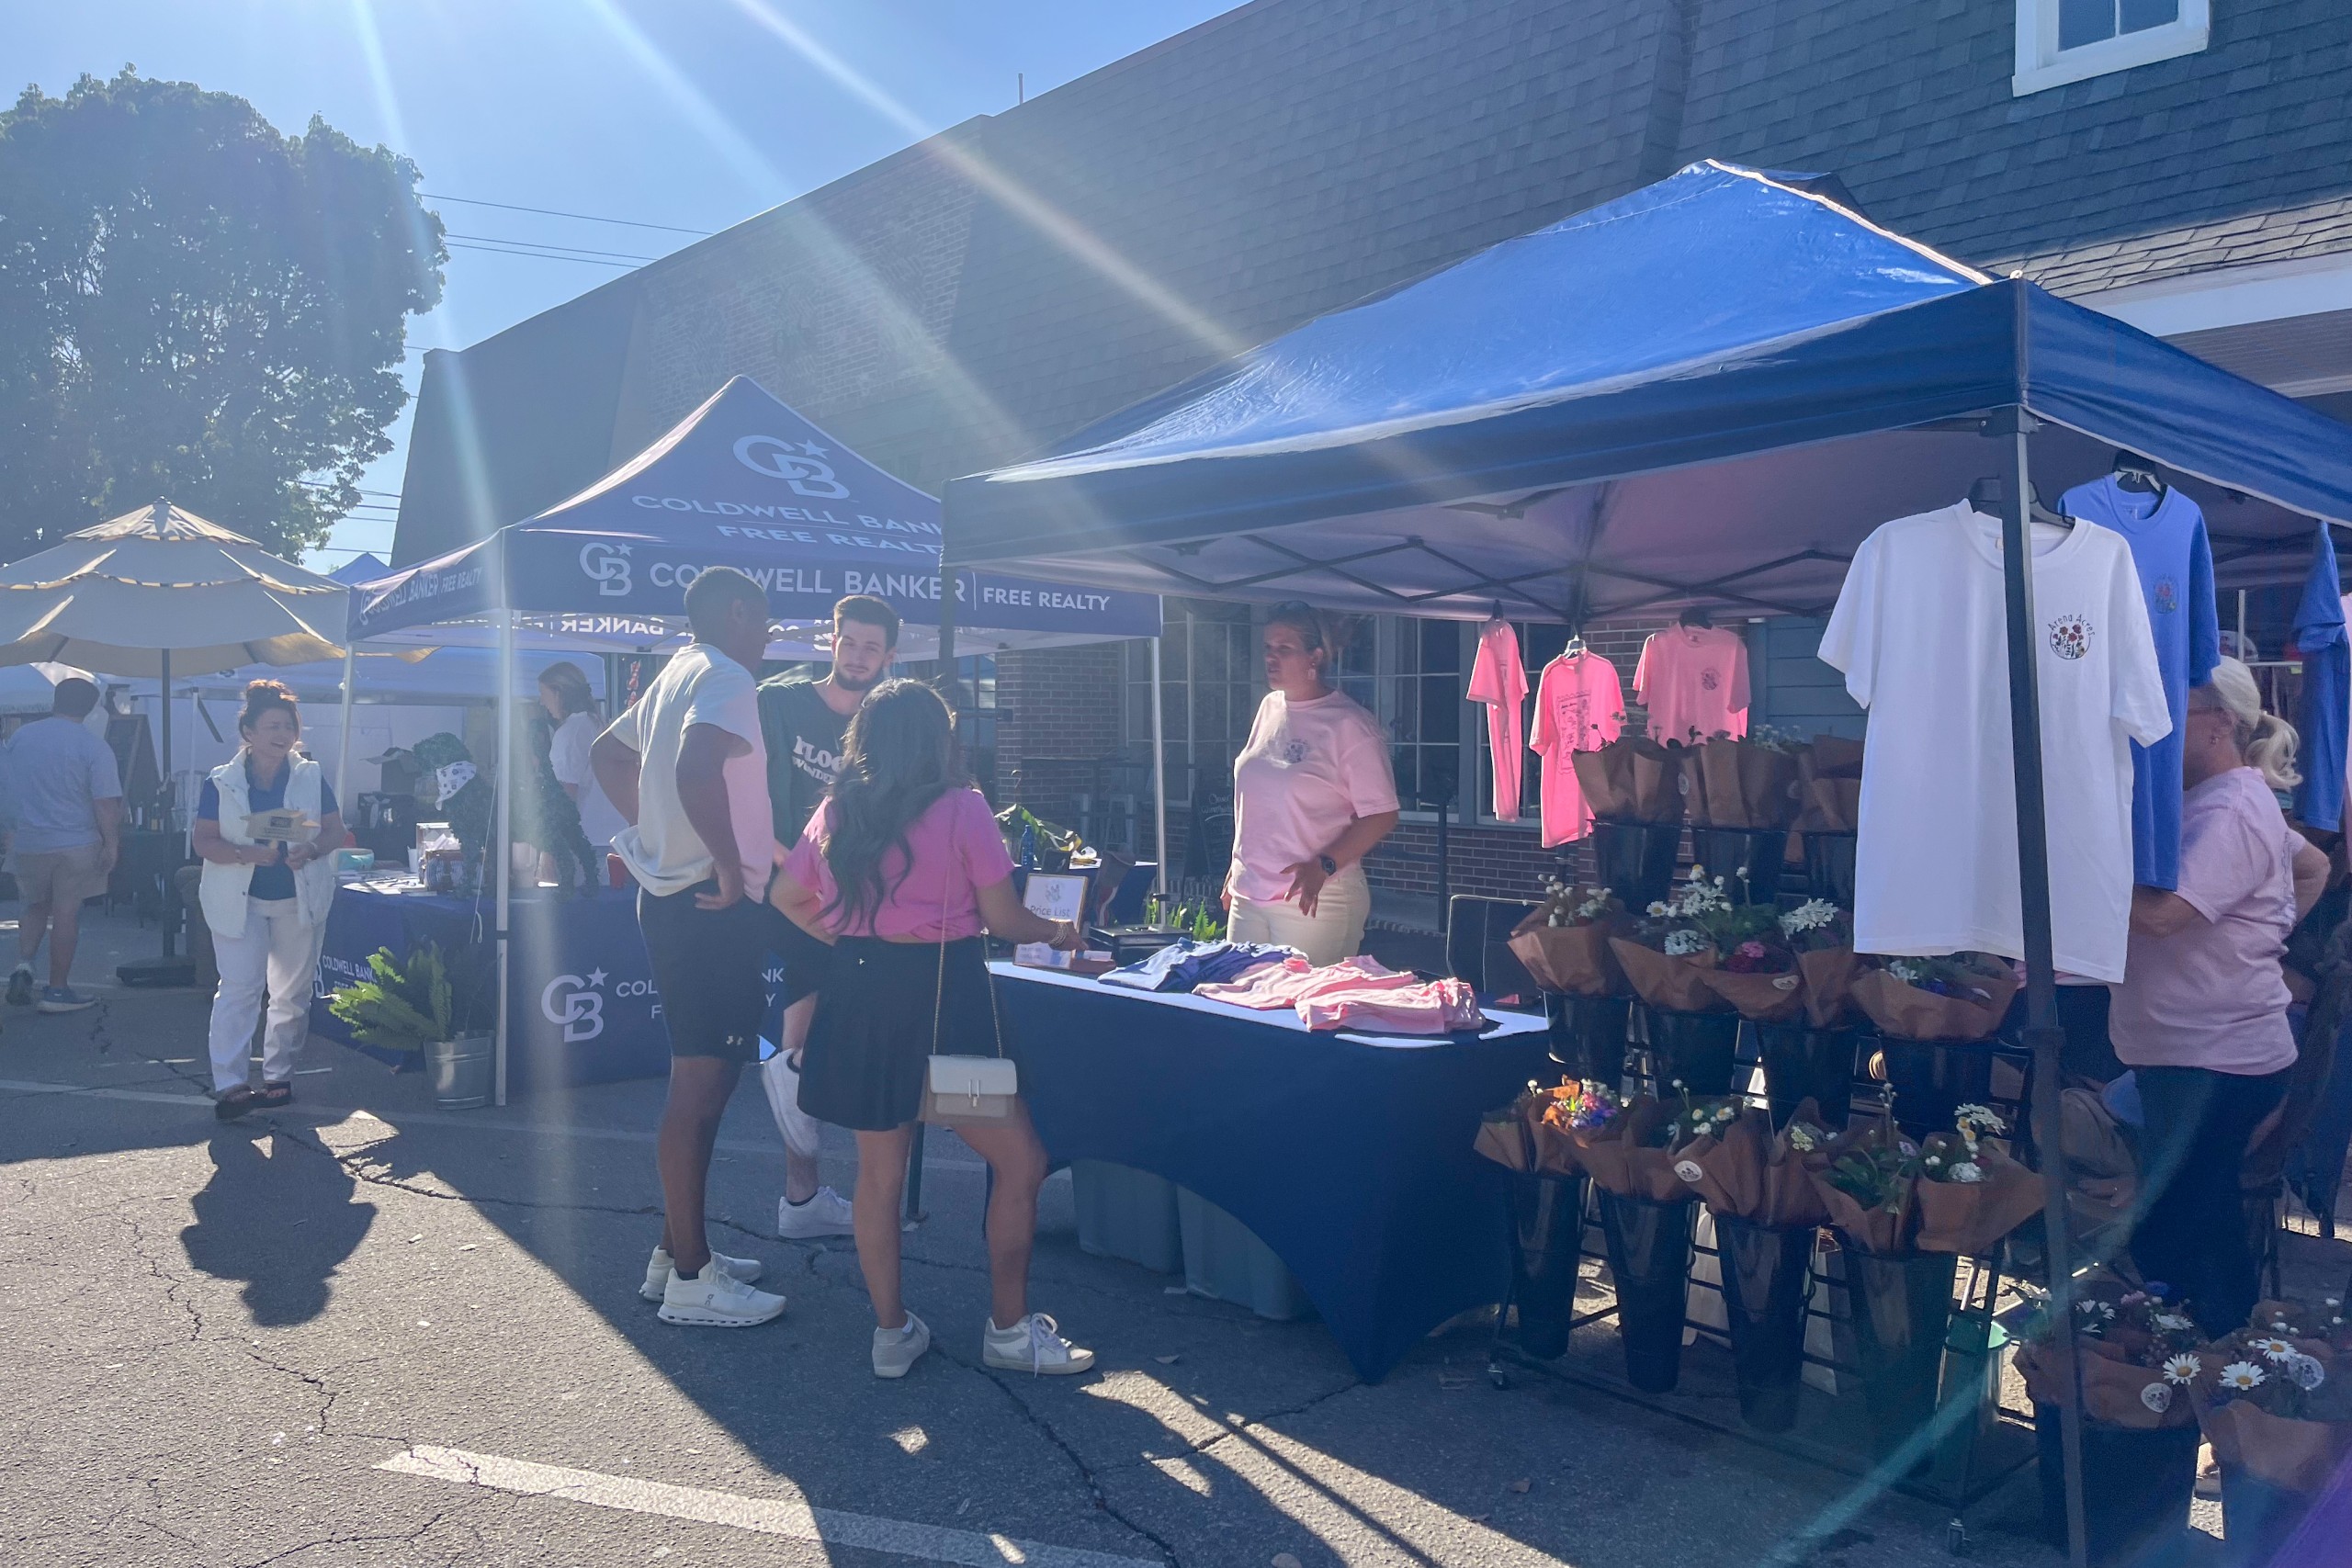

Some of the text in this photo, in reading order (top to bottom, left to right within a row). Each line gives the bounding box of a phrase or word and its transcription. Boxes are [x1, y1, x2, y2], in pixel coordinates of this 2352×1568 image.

[631, 495, 942, 536] COLDWELL BAN
[716, 525, 944, 556] FREE REALT
[441, 573, 458, 594] FREE
[458, 567, 484, 591] REALTY
[650, 561, 1110, 611] COWELL BANKER FREE REALTY
[1054, 907, 1070, 918] List
[322, 954, 378, 984] COLDWELL BANK
